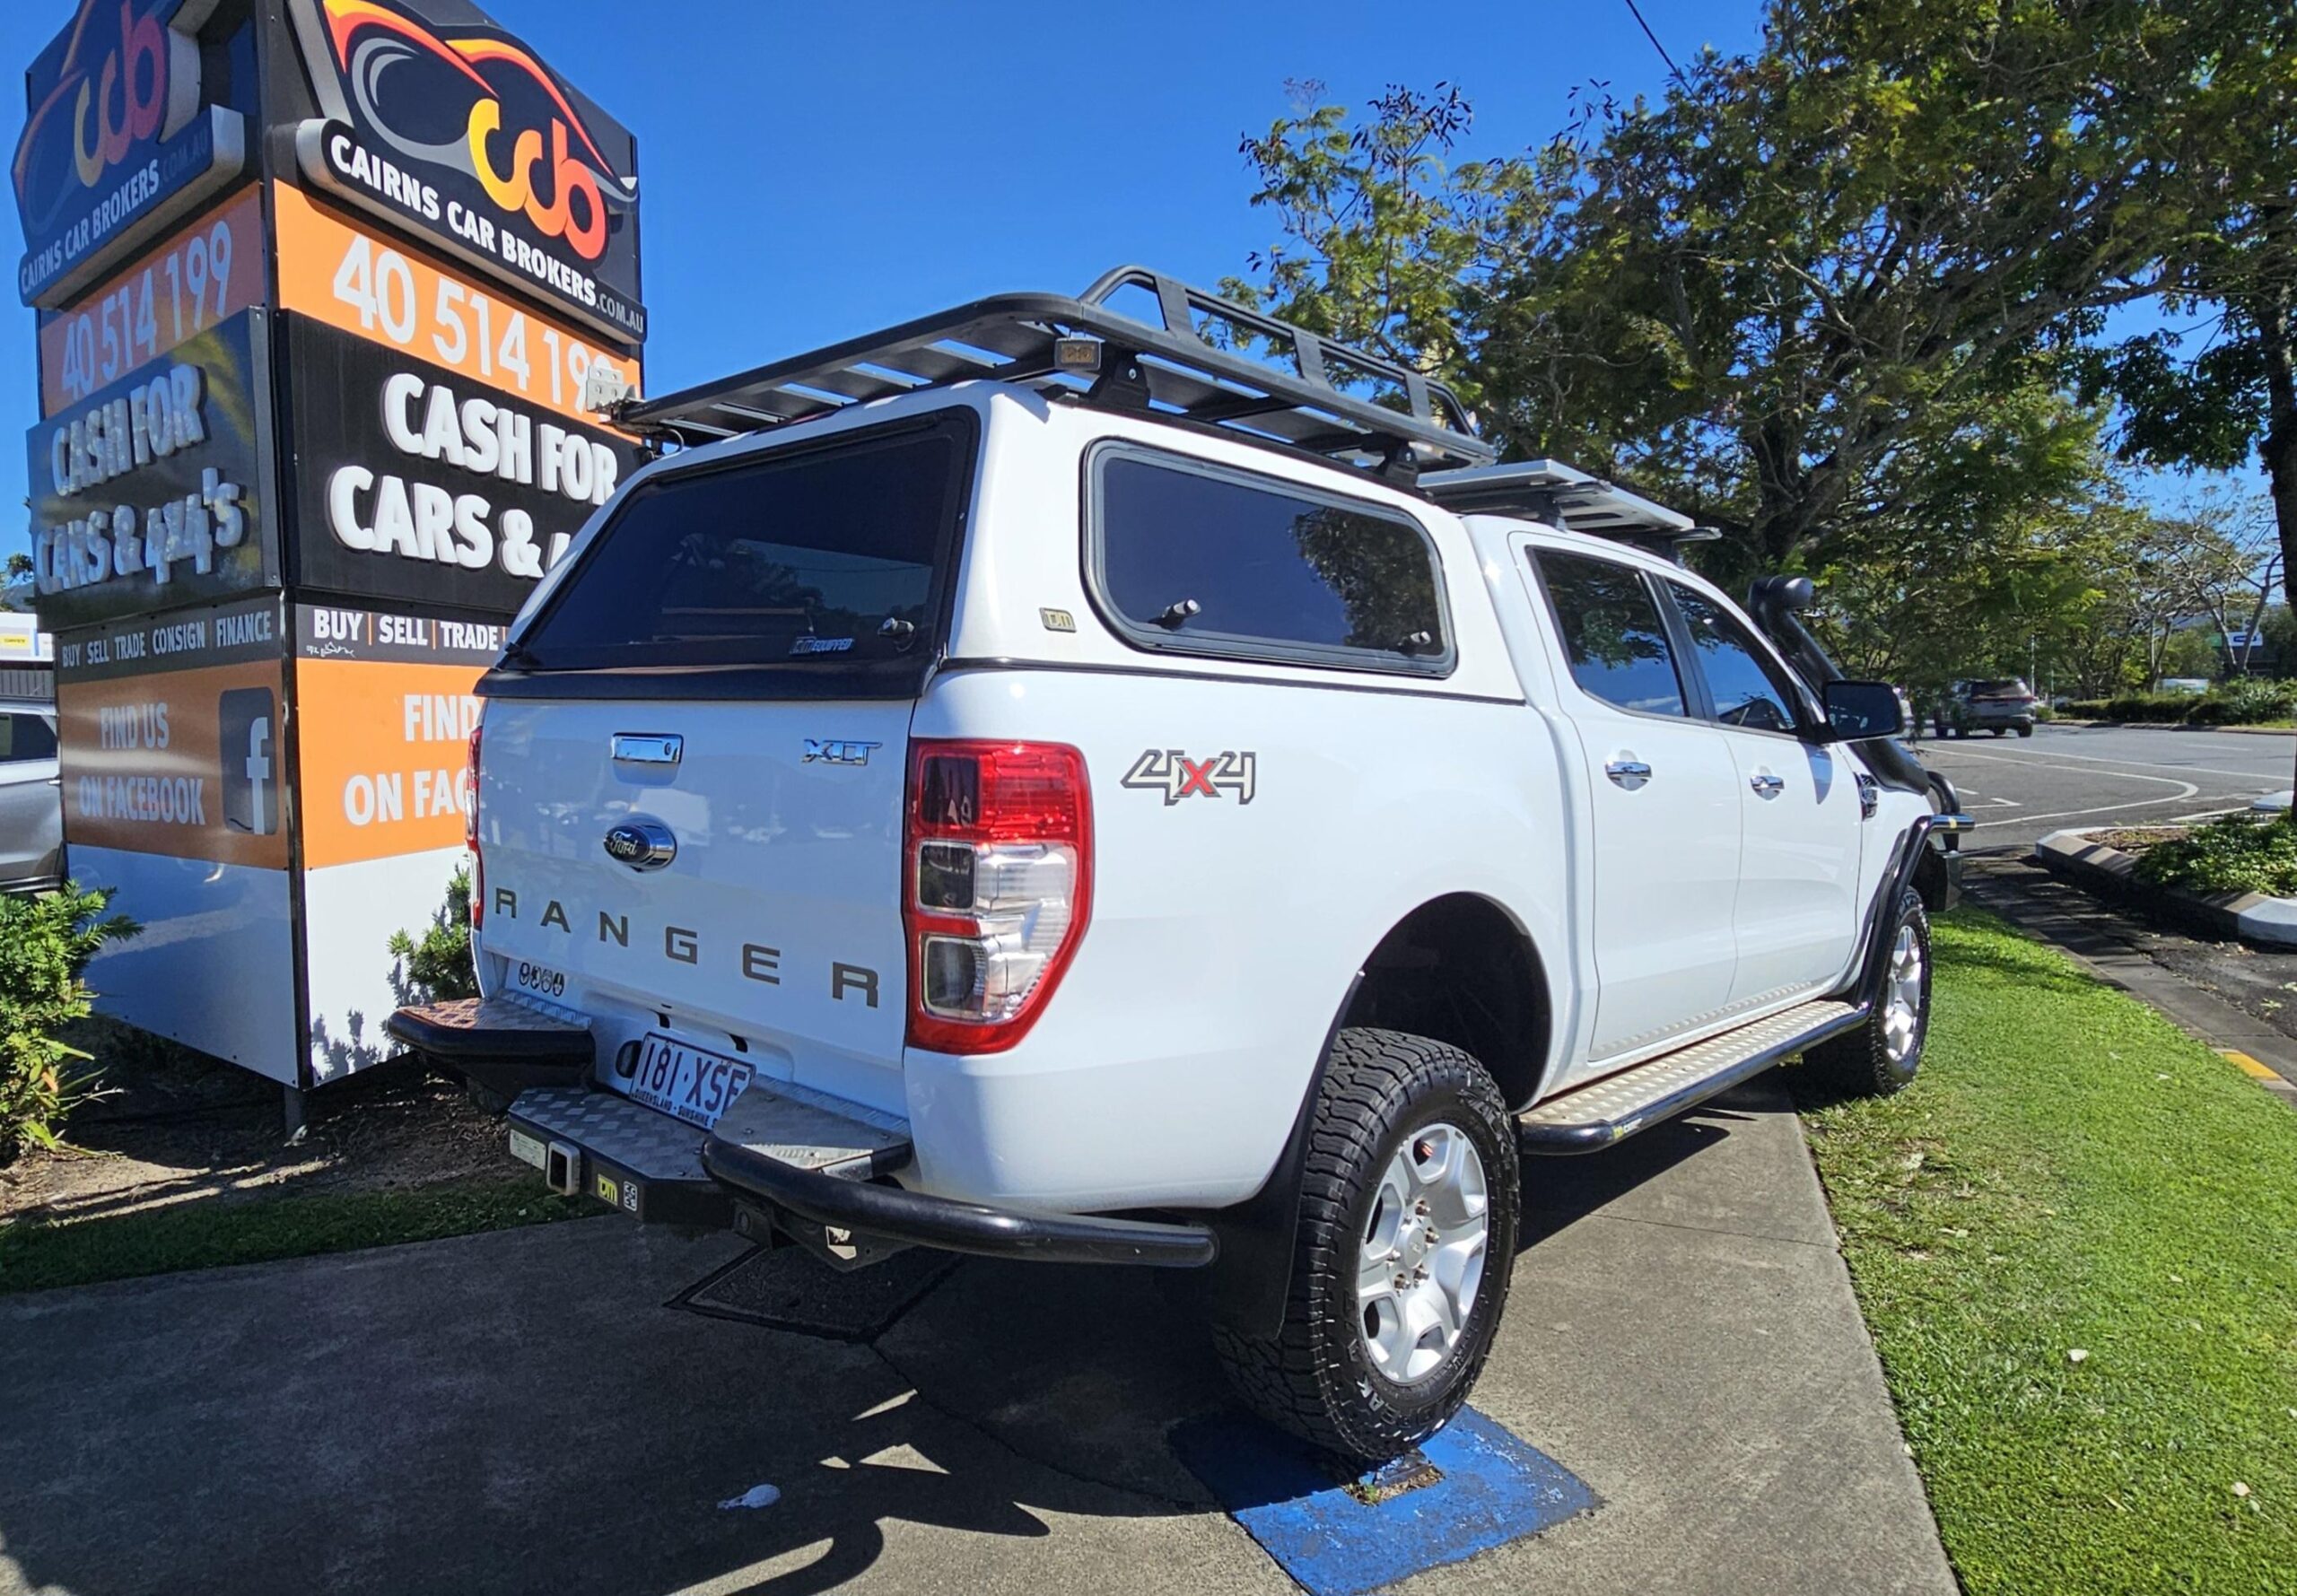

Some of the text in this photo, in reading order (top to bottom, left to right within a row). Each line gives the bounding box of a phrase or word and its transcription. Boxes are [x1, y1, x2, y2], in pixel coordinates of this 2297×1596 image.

[330, 135, 440, 221] CAIRNS
[447, 201, 496, 253] CAR
[22, 240, 62, 294] CAIRNS
[65, 223, 90, 260] CAR
[62, 220, 231, 401] 40 514 199
[333, 233, 416, 344] 40
[432, 276, 530, 391] 514
[52, 363, 205, 496] CASH FOR
[381, 373, 618, 506] CASH FOR
[36, 510, 112, 596] CARS
[113, 505, 144, 576] &
[327, 466, 493, 569] CARS
[499, 509, 545, 578] &
[62, 611, 272, 667] BUY SELL TRADE CONSIGN FINANCE
[313, 608, 499, 650] BUY SELL TRADE
[100, 702, 170, 749] FIND US
[404, 693, 482, 742] FIND
[802, 738, 883, 766] XLT
[79, 776, 205, 825] ON FACEBOOK
[344, 772, 403, 826] ON
[610, 831, 638, 855] Ford
[495, 888, 878, 1008] RANGER
